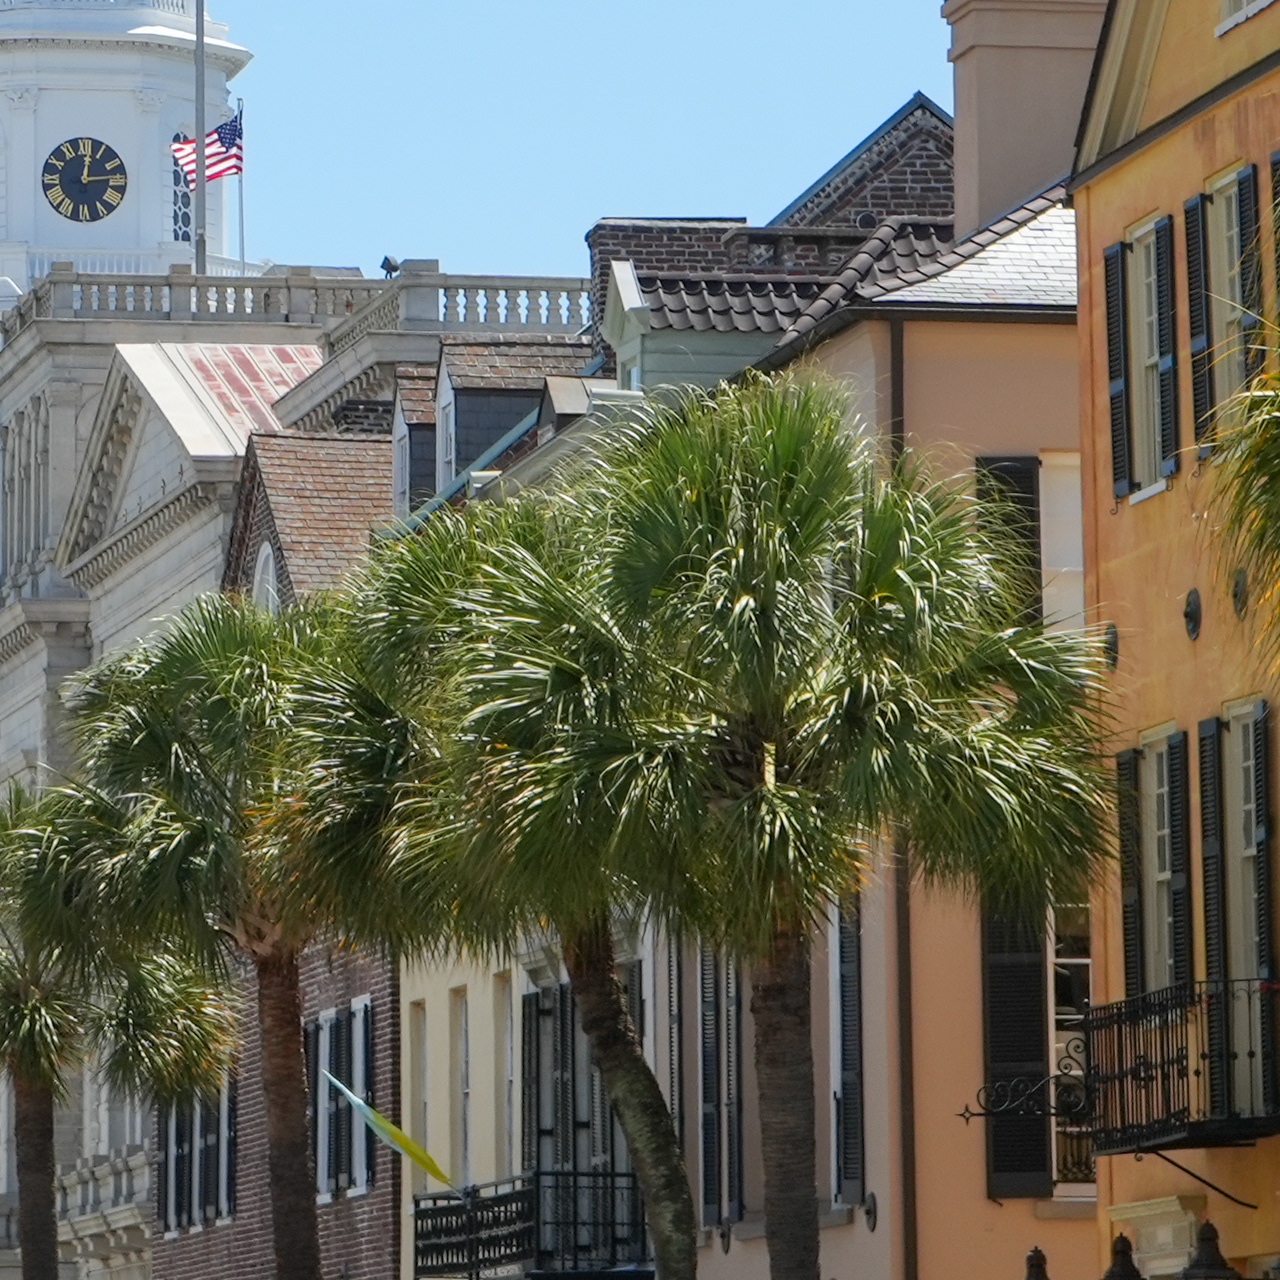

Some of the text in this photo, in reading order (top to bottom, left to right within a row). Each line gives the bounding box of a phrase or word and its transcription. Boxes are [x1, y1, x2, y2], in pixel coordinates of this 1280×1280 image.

[60, 142, 76, 160] XI
[78, 139, 92, 155] XII
[95, 144, 106, 159] I
[48, 155, 65, 170] X
[105, 158, 121, 170] II
[44, 173, 60, 184] IX
[46, 185, 66, 206] VIII
[102, 187, 122, 206] IIII
[58, 197, 74, 217] VII
[79, 204, 90, 220] VI
[96, 201, 108, 217] V
